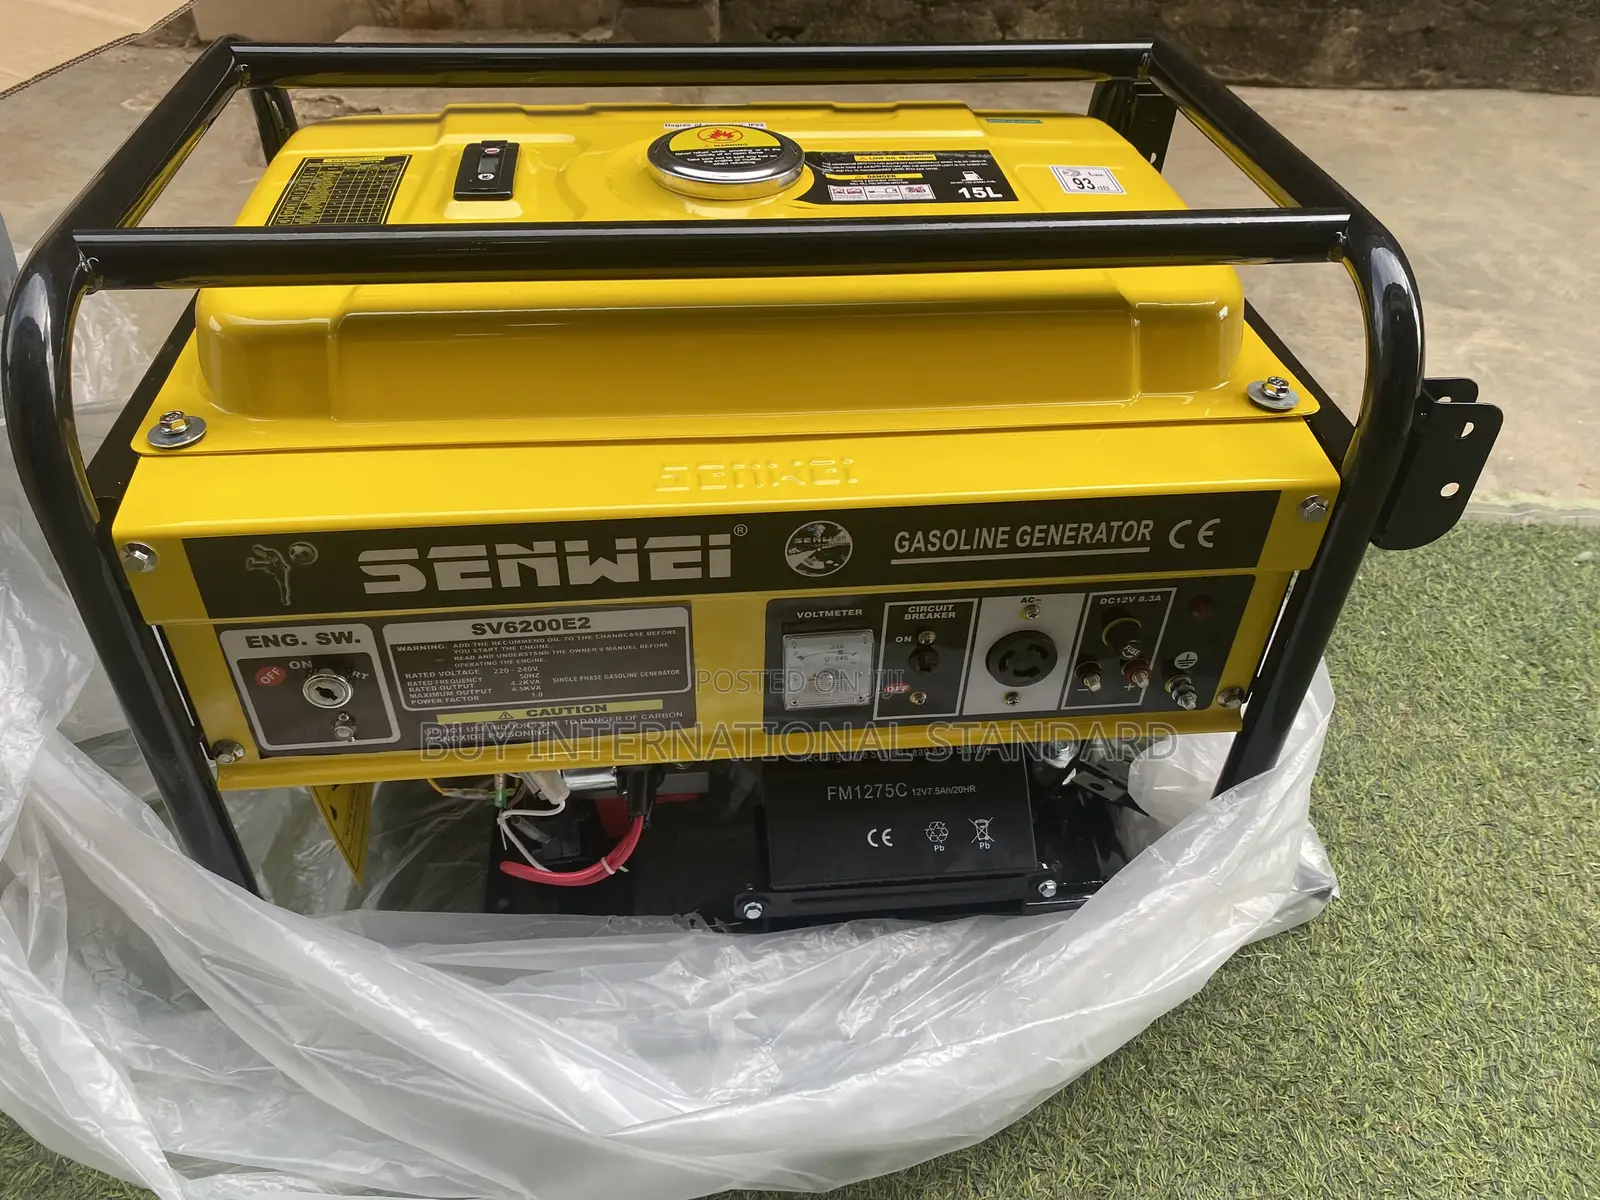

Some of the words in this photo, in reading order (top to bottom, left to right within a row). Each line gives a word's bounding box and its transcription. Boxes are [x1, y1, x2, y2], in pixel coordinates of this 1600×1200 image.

[1072, 177, 1096, 190] 93
[958, 186, 1003, 199] 15L
[655, 458, 859, 492] SENWEI
[893, 526, 1010, 554] GASOLINE
[1015, 519, 1154, 548] GENERATOR
[357, 533, 732, 594] SENWEI
[1100, 596, 1136, 605] DC12V
[797, 609, 863, 619] VOLTMETER
[908, 605, 955, 613] CIRCUIT
[904, 612, 957, 621] BREAKER
[471, 616, 592, 636] SV6200E2
[245, 633, 308, 648] ENG.
[315, 631, 361, 646] SW.
[397, 644, 447, 652] WARNING:
[492, 638, 545, 646] RECOMMEND
[496, 650, 549, 659] UNDERSTAND
[1123, 644, 1141, 657] FUSE
[289, 660, 312, 669] ON
[454, 660, 498, 668] OPERATING
[260, 667, 281, 684] OFF
[405, 671, 436, 679] RATED
[438, 669, 481, 677] VOLTAGE
[552, 675, 578, 683] SINGLE
[580, 674, 602, 682] PHASE
[604, 672, 638, 680] GASOLINE
[640, 669, 680, 678] GENERATOR
[435, 677, 483, 685] FREQUENCY
[440, 683, 475, 691] OUTPUT
[409, 691, 454, 699] MAXIMUM
[456, 688, 493, 696] OUTPUT
[886, 685, 909, 694] OFF
[445, 695, 480, 703] FACTOR
[526, 704, 607, 717] CAUTION
[641, 711, 683, 720] CARBON
[827, 782, 908, 801] FM1275C
[911, 785, 976, 796] 12V7.5Ah/20HR
[867, 828, 893, 847] CE
